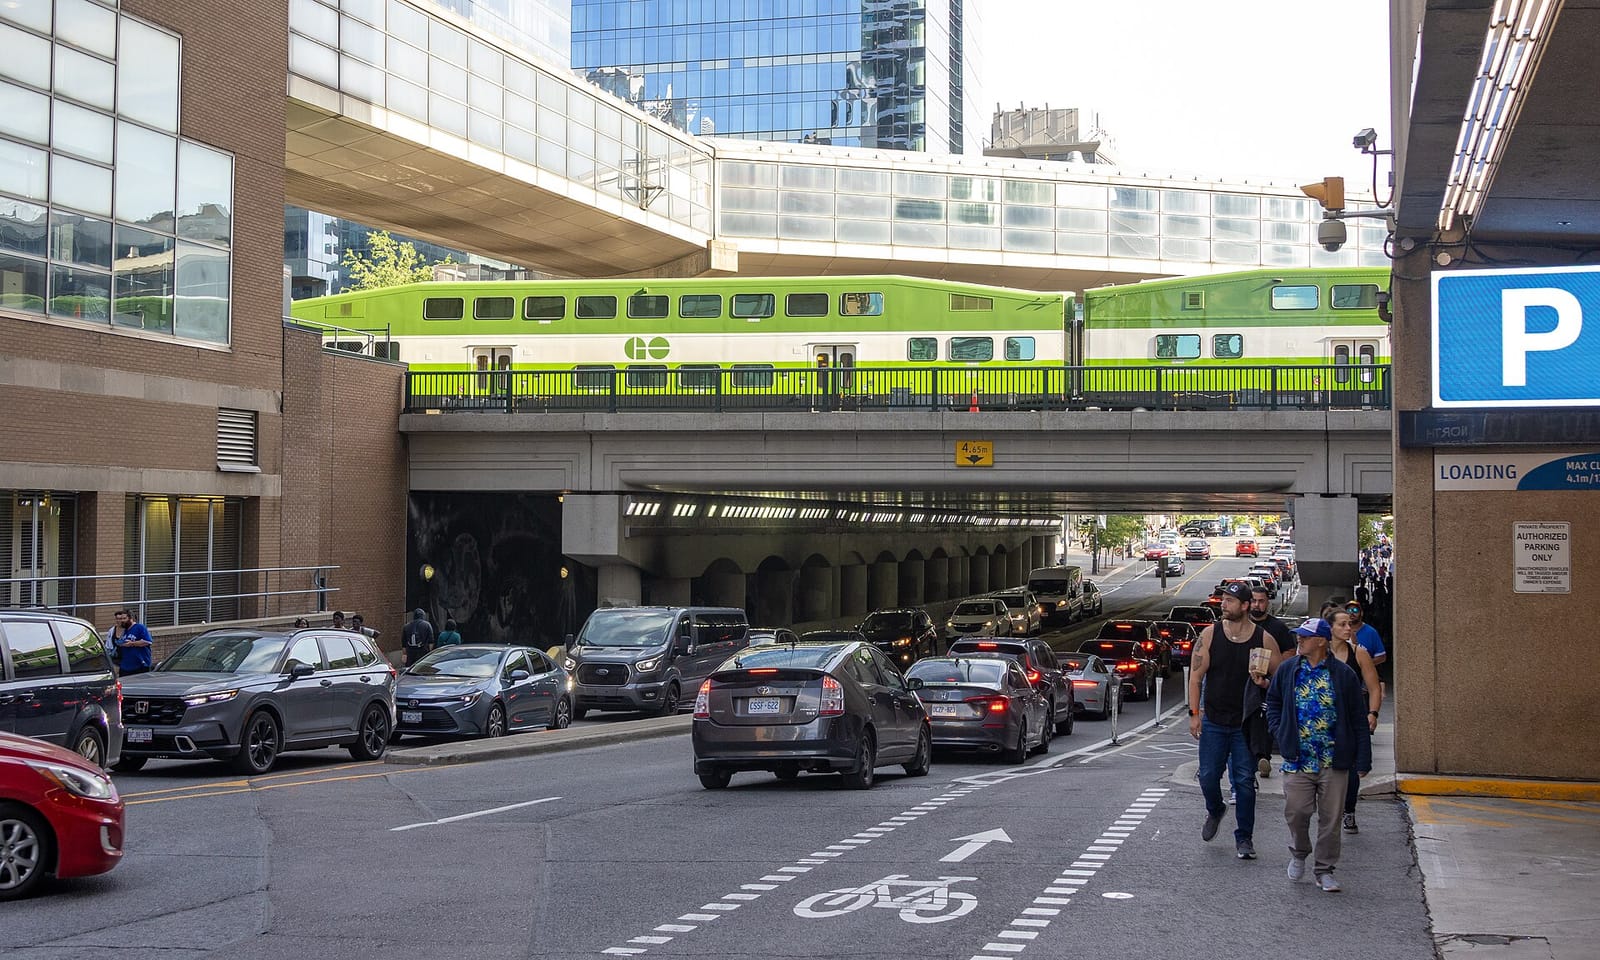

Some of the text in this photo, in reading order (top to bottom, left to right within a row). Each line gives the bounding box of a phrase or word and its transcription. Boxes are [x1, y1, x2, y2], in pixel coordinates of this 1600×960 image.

[1501, 287, 1584, 387] P
[962, 442, 988, 453] 4.65m
[1566, 461, 1587, 470] MAX
[1440, 464, 1517, 480] LOADING
[1516, 533, 1568, 541] AUTHORIZED
[1524, 543, 1560, 551] PARKING
[1531, 554, 1553, 562] ONLY
